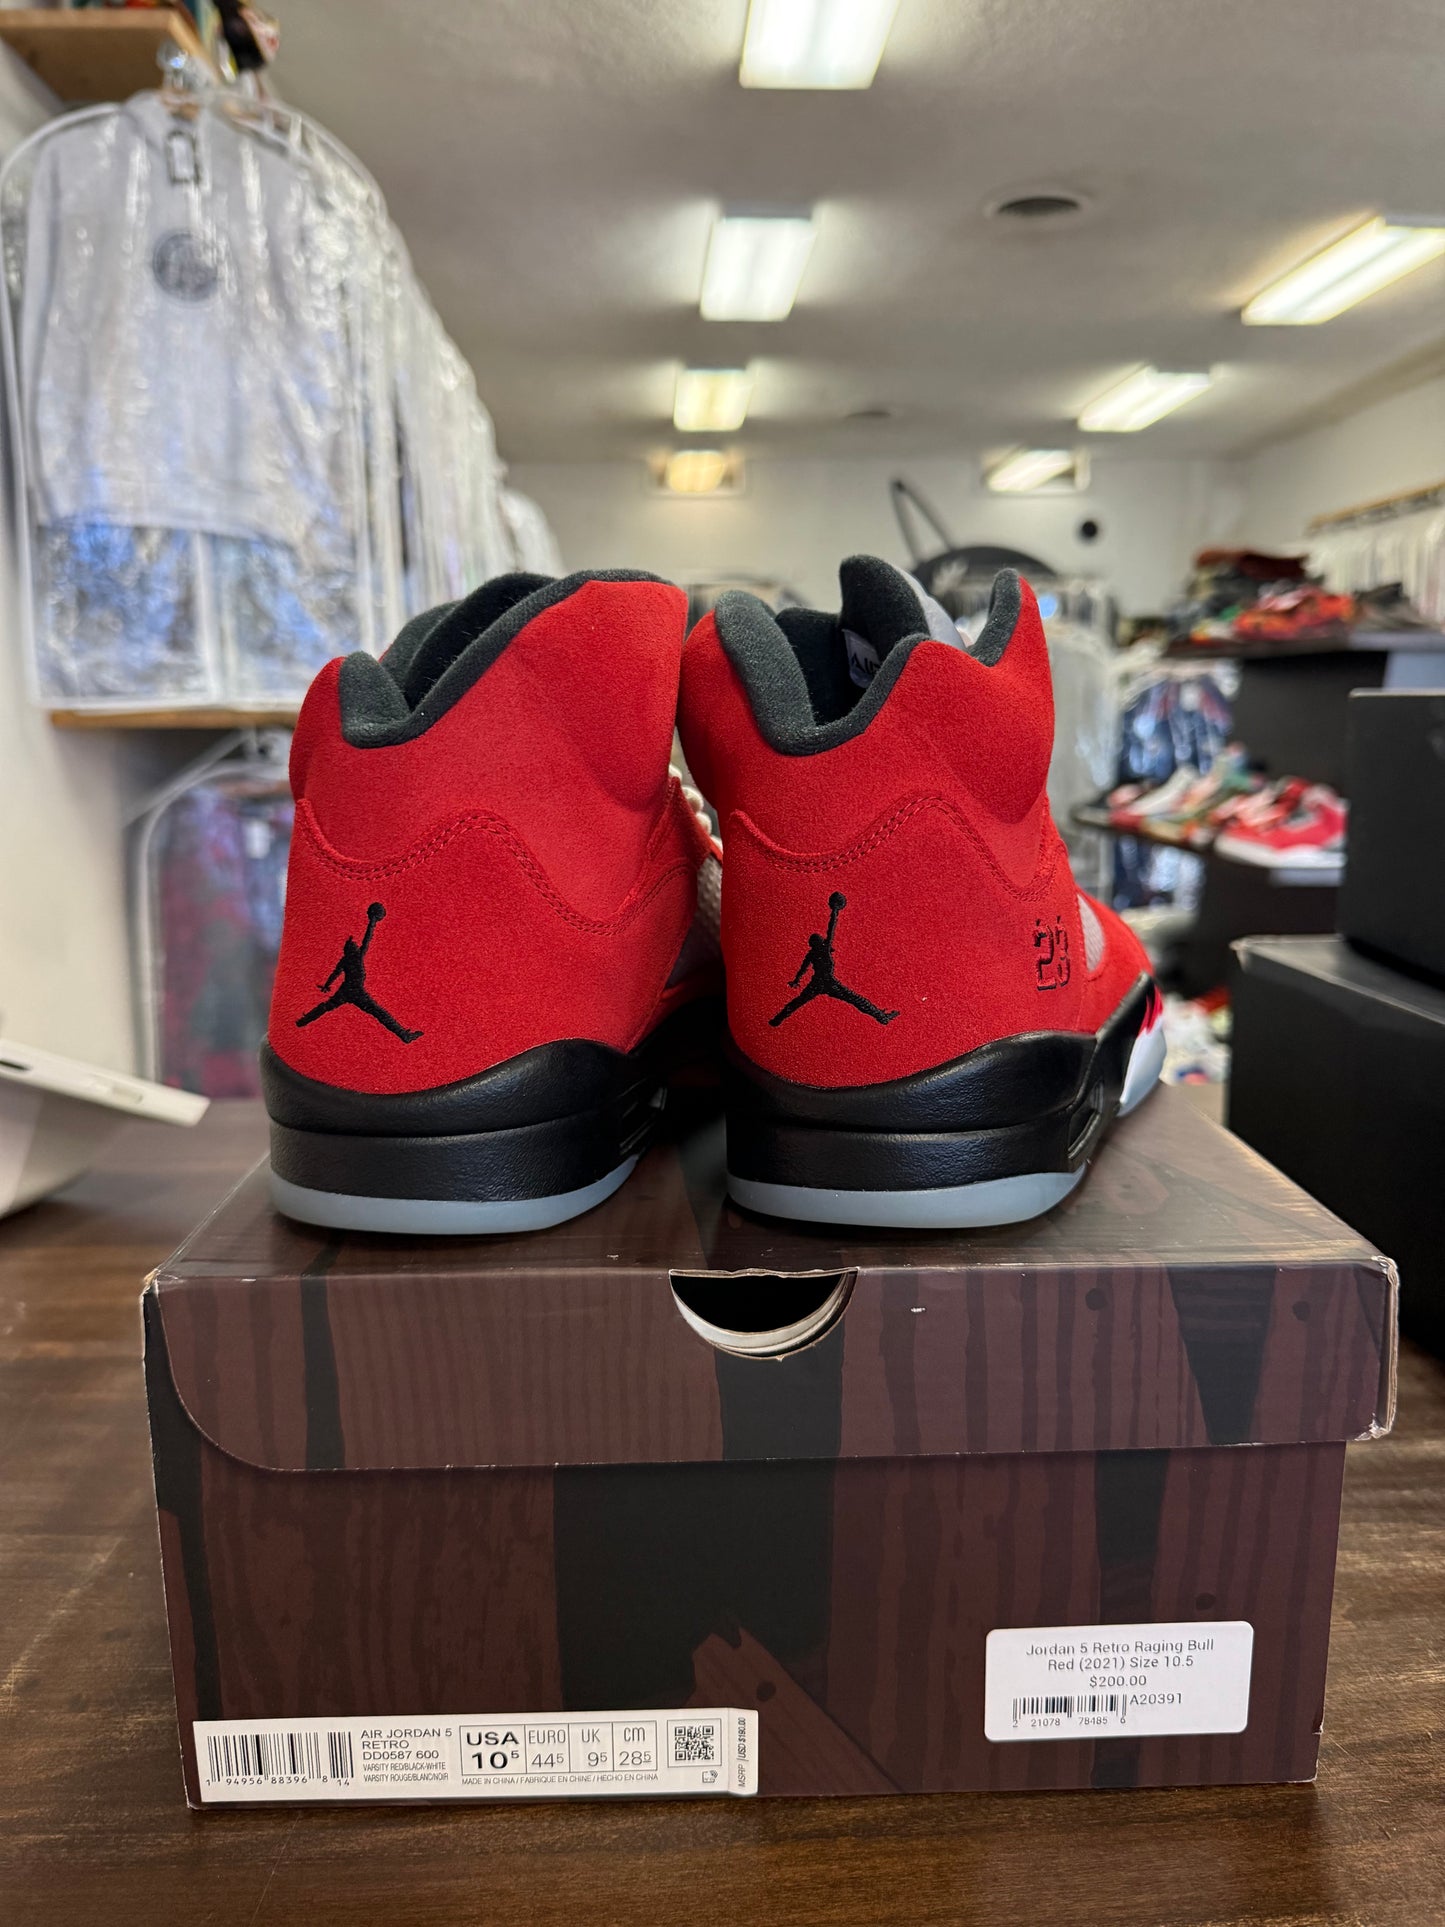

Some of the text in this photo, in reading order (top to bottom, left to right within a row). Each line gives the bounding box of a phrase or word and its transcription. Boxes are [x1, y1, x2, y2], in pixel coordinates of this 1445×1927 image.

[1033, 915, 1071, 991] 23
[1026, 1639, 1214, 1657] Jordan 5 Retro Raging Bull
[1048, 1655, 1194, 1671] Red (2021) Size 10.5
[1089, 1675, 1147, 1688] $200.00
[1130, 1693, 1183, 1705] A20391
[1012, 1716, 1126, 1728] 2 21078 78485 6
[361, 1728, 452, 1739] AIR JORDAN 5
[466, 1731, 519, 1746] USA
[528, 1730, 566, 1744] EURO
[581, 1728, 600, 1742] UK
[362, 1740, 409, 1749] RETRO
[362, 1750, 439, 1760] DD0587 600
[363, 1761, 446, 1772] VARSITY RED/BLACK-WHITE
[226, 1778, 263, 1786] 94956
[364, 1773, 389, 1782] VARSITY
[520, 1776, 556, 1784] FABRIQUE
[569, 1775, 592, 1783] CHINE
[597, 1774, 622, 1782] HECHO
[737, 1764, 746, 1788] MSRP
